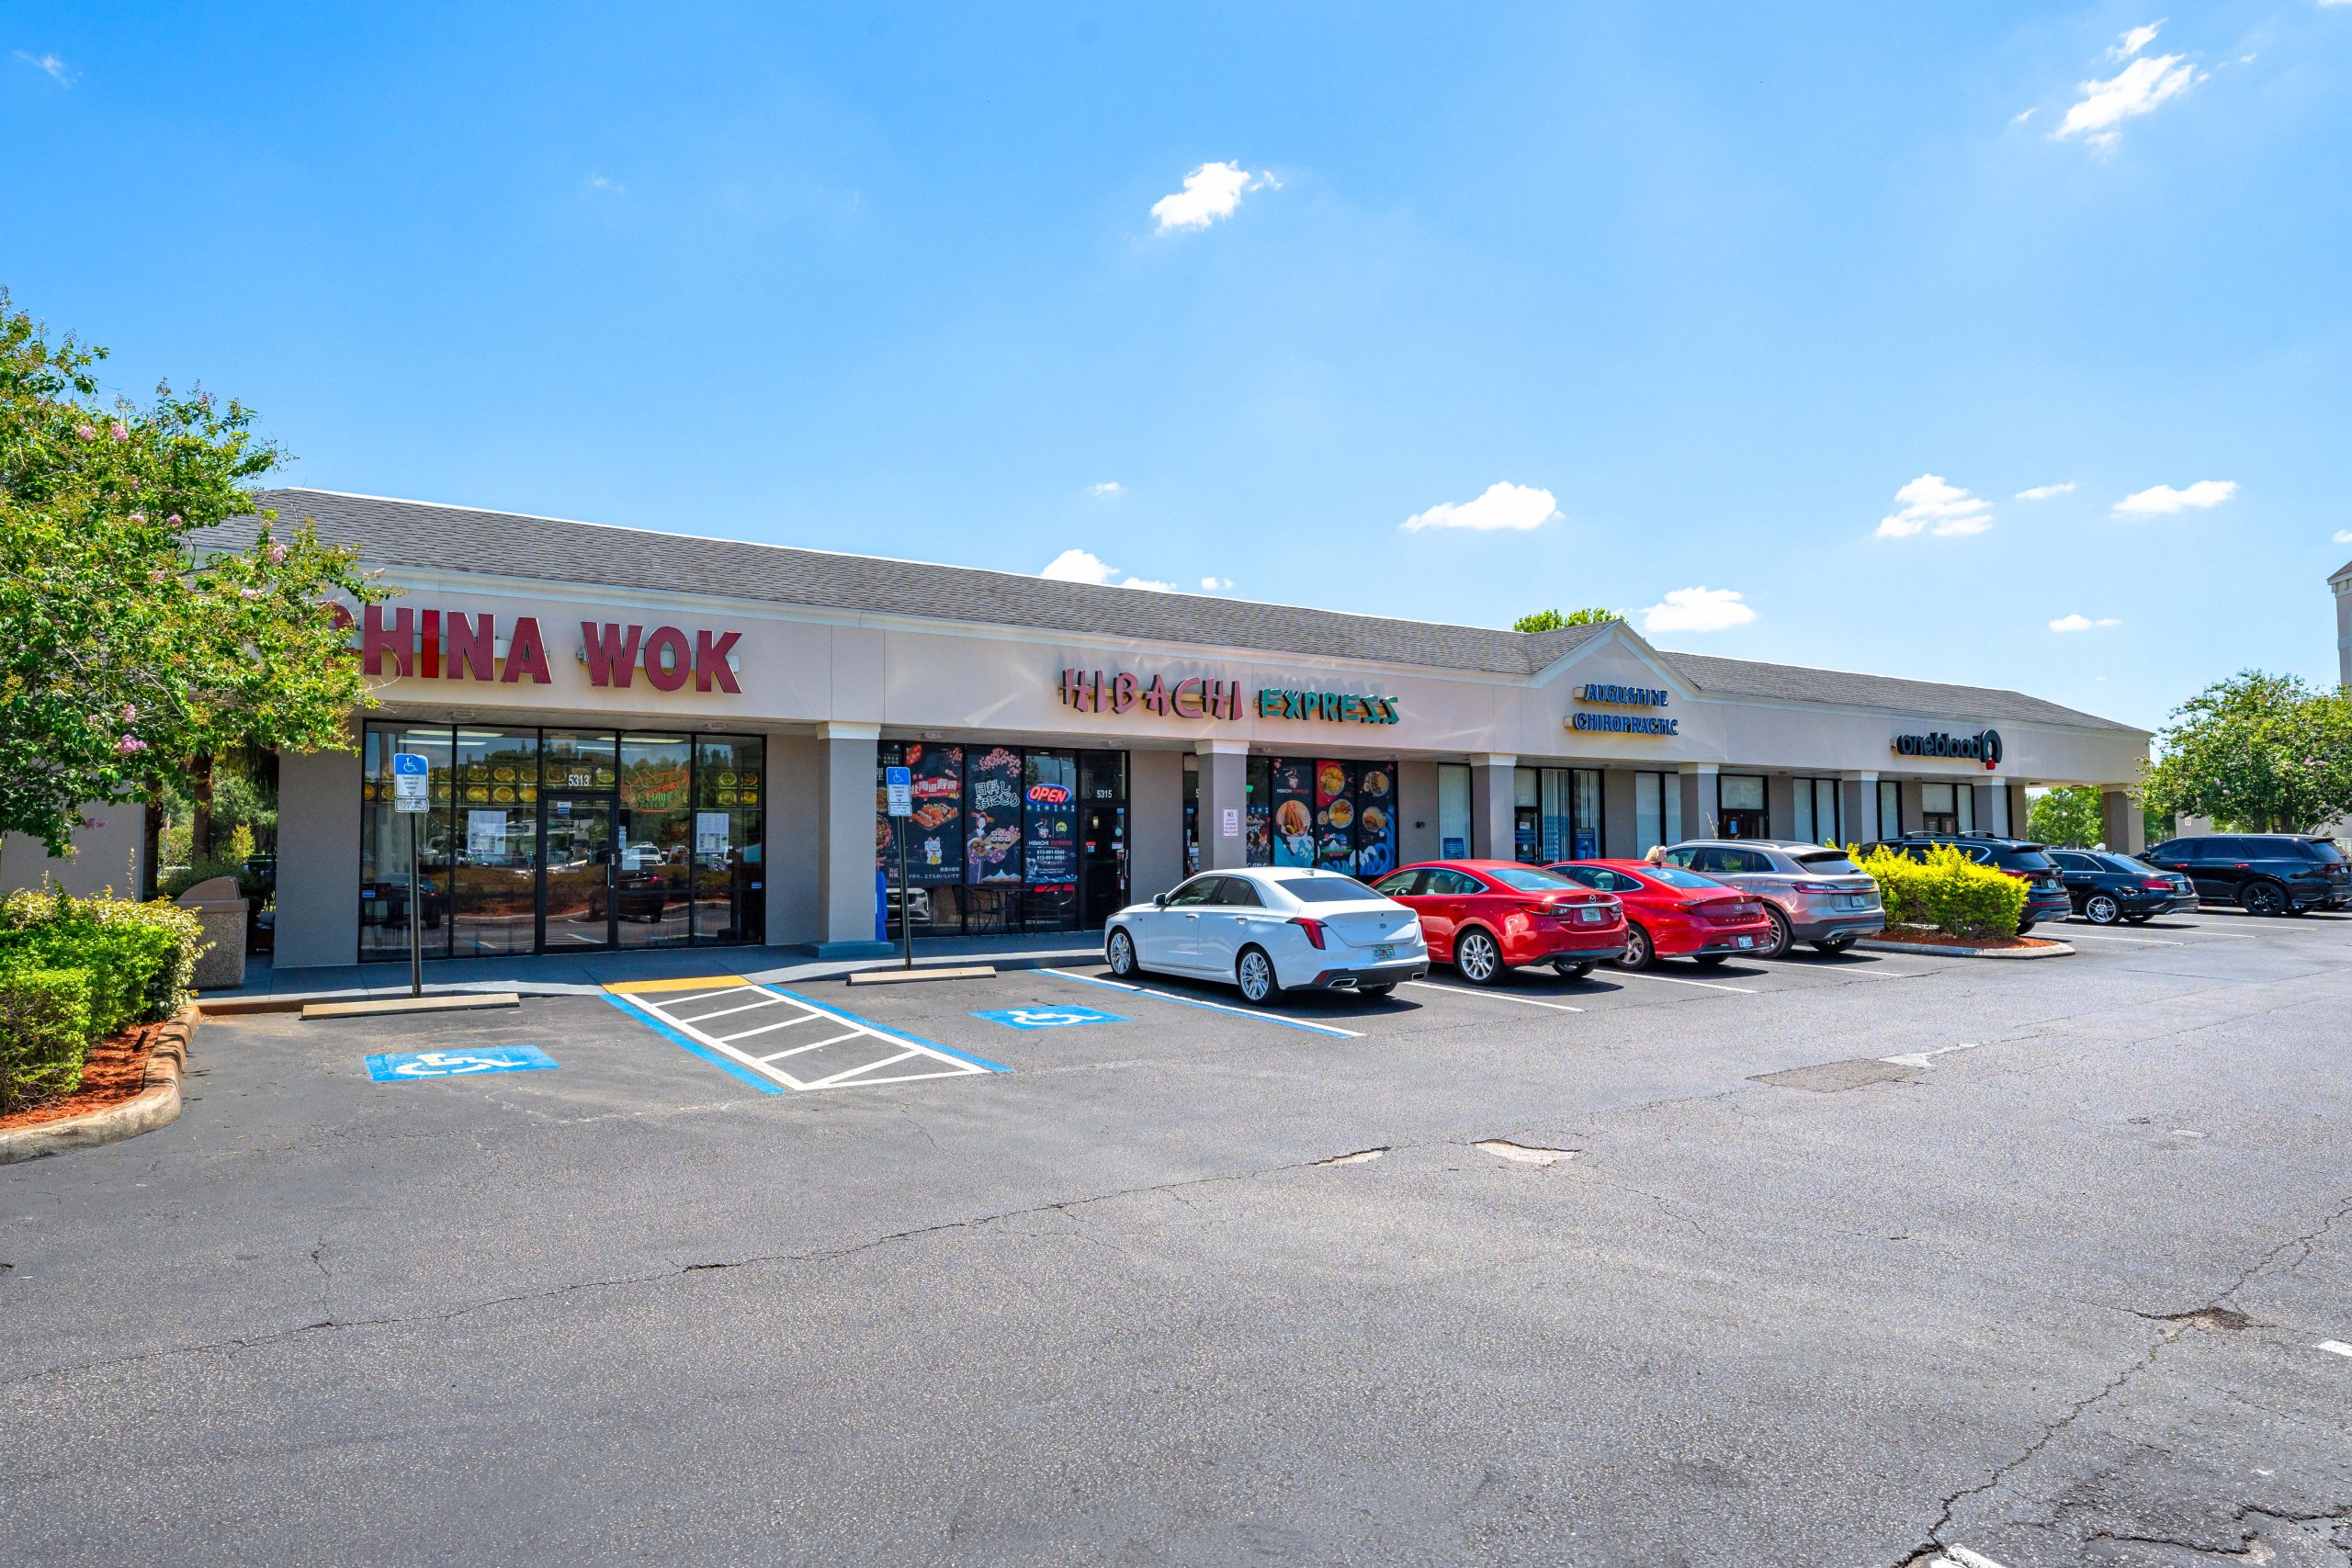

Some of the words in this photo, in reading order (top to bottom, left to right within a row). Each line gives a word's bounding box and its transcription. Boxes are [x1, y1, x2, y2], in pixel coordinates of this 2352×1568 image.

[581, 621, 743, 694] WOK
[1062, 669, 1243, 720] HIBACHI
[1259, 687, 1399, 725] EXPRESS
[1585, 683, 1668, 706] AUGUSTINE
[1573, 713, 1679, 736] CHIROPRACTIC
[1896, 732, 1983, 759] oneblood
[568, 773, 590, 788] 5313
[1029, 785, 1068, 804] OPEN
[1096, 789, 1113, 798] 5315
